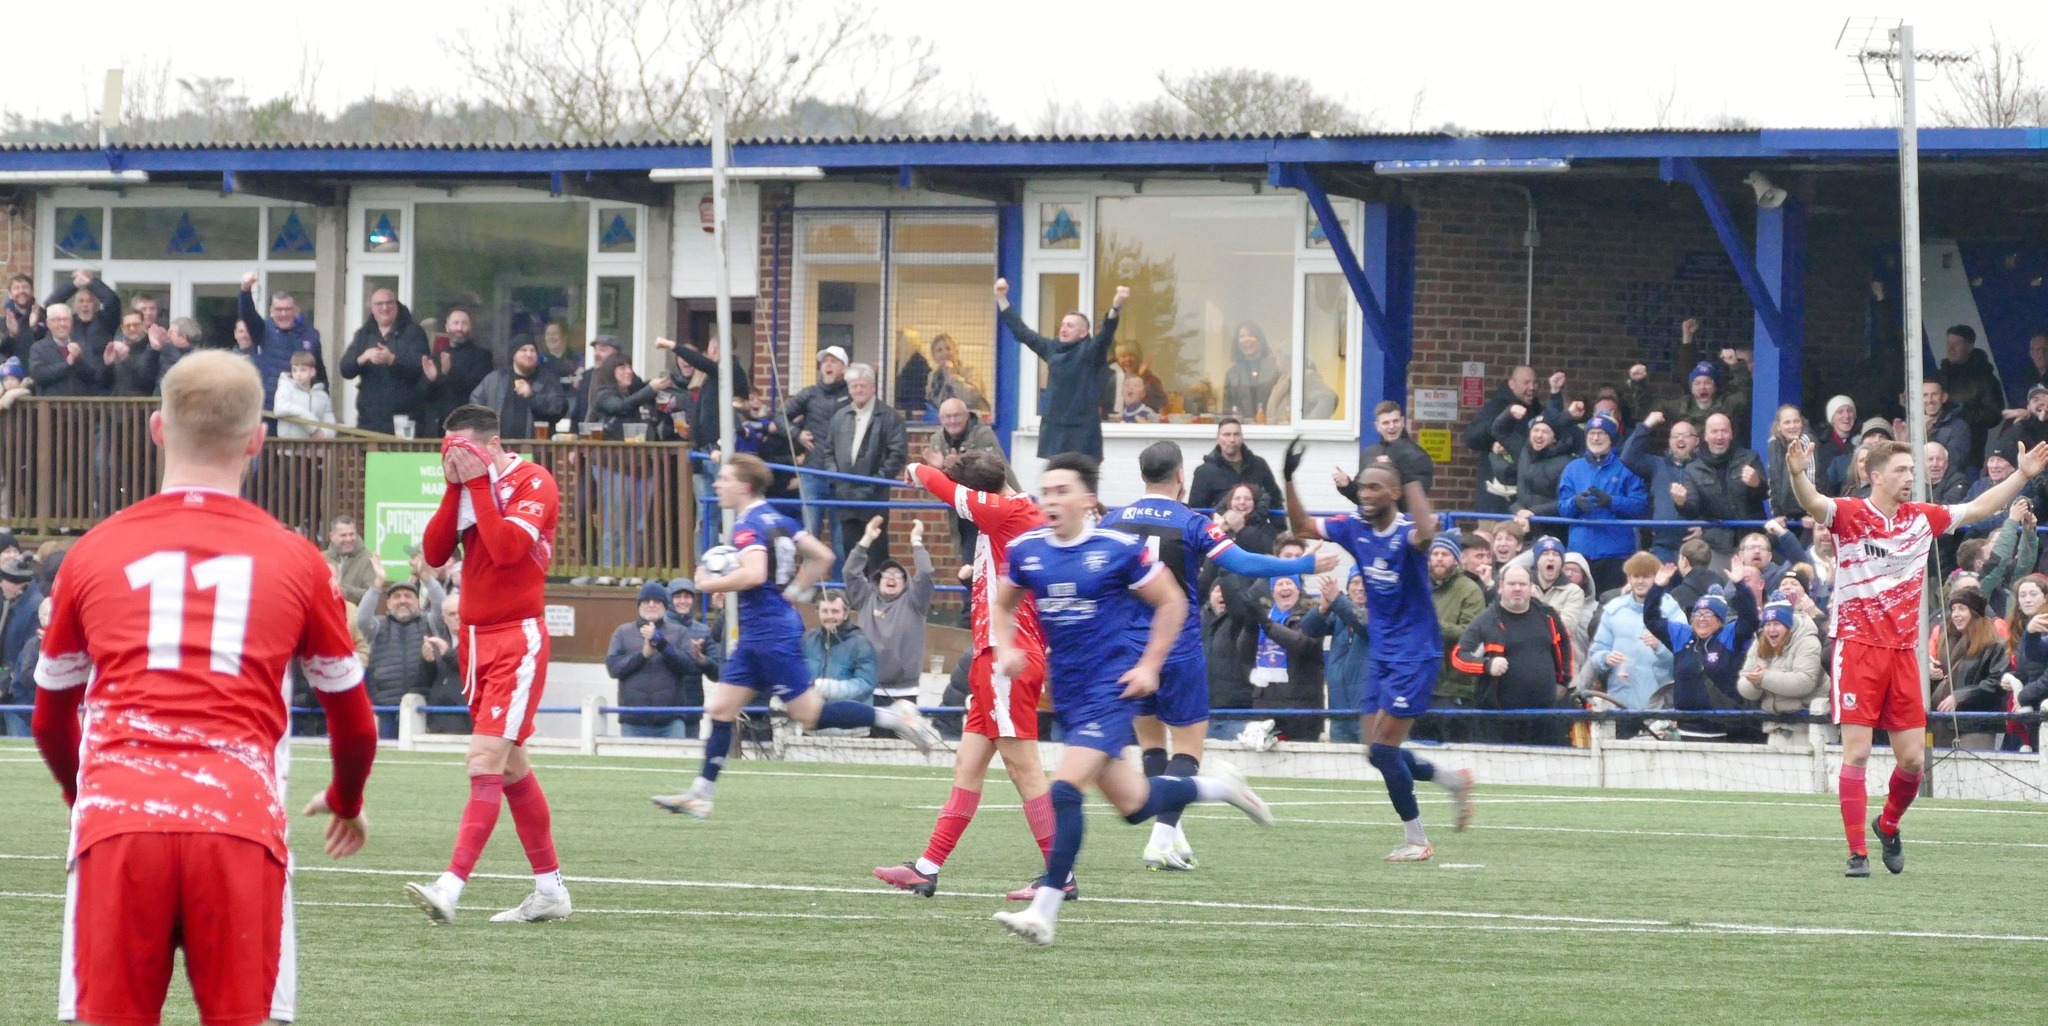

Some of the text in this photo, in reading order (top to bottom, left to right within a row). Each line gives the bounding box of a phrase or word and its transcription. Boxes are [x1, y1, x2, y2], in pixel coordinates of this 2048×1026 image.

[420, 465, 444, 476] WELC
[421, 482, 448, 495] MAR
[1136, 508, 1172, 517] KELF
[386, 510, 436, 534] PITCHIN
[123, 550, 254, 677] 11
